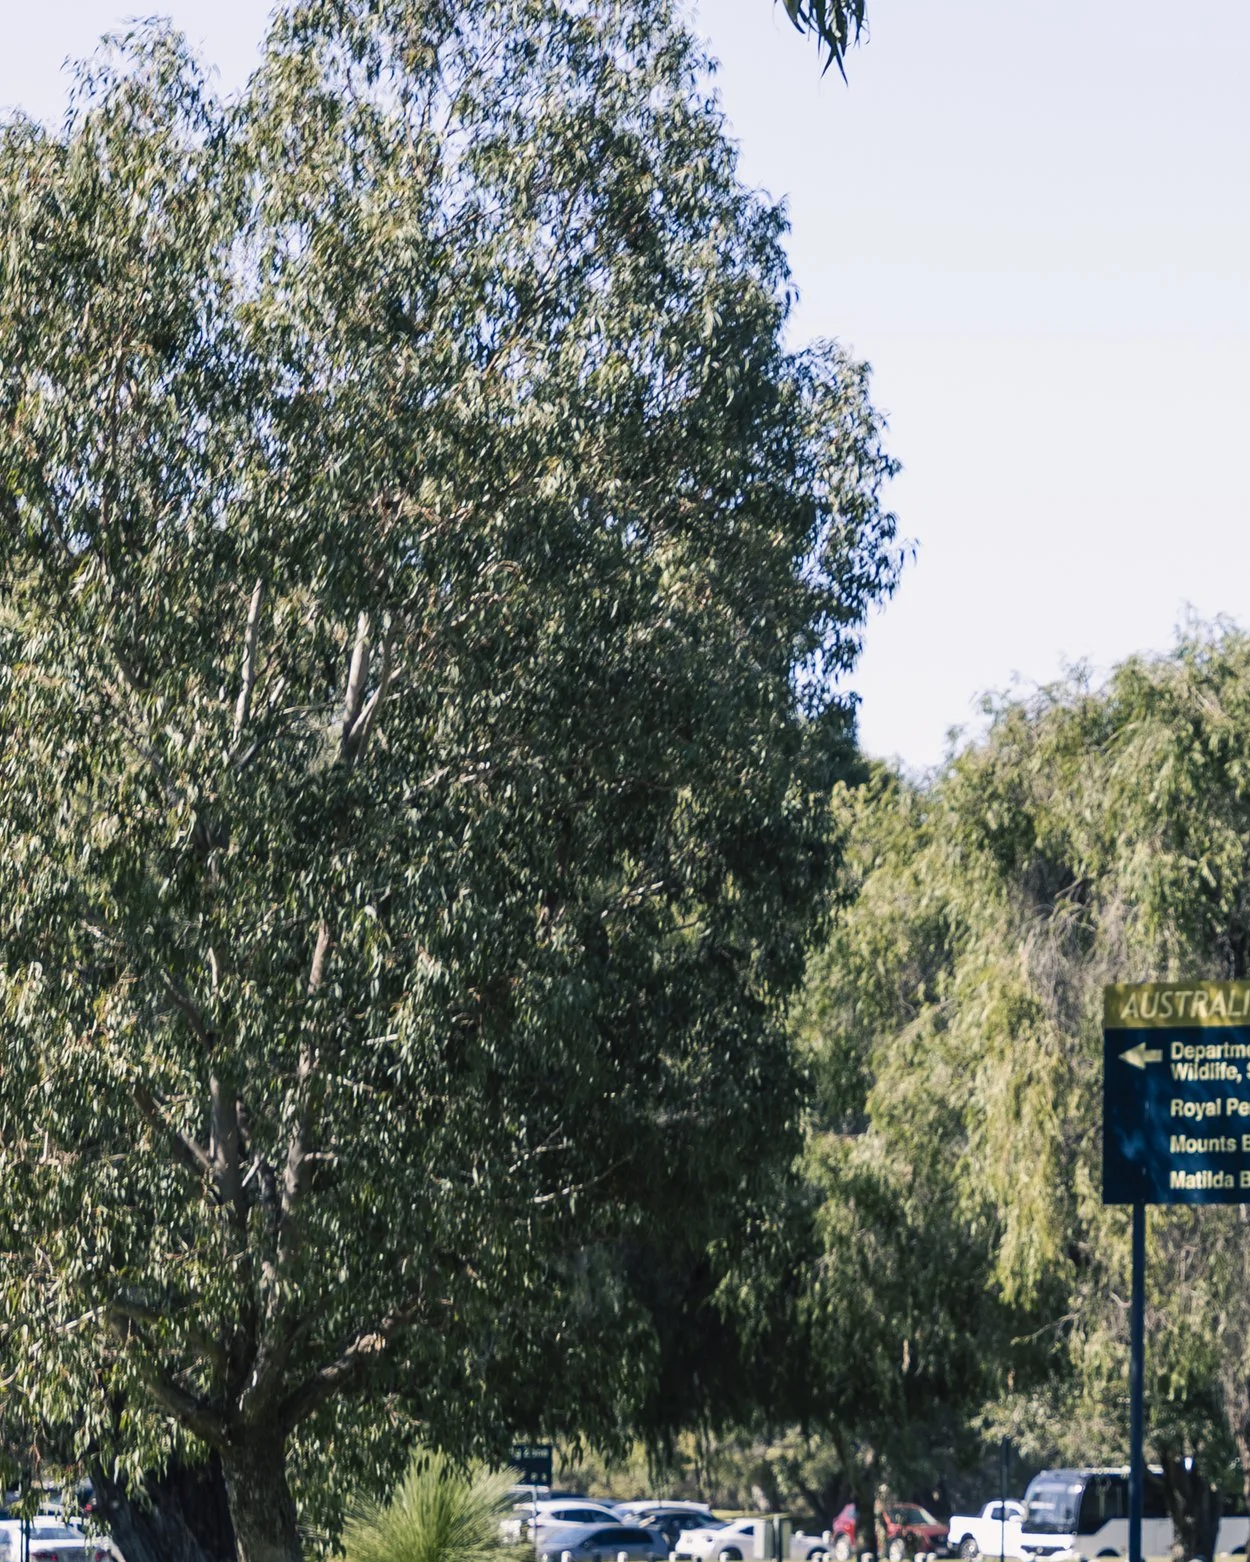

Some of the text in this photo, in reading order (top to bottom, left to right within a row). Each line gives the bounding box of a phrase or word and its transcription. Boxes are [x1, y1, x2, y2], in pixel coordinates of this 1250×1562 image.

[1170, 1061, 1243, 1084] Wildlife,
[1170, 1098, 1222, 1121] Royal
[1170, 1135, 1237, 1154] Mounts
[1170, 1170, 1235, 1190] Matilda
